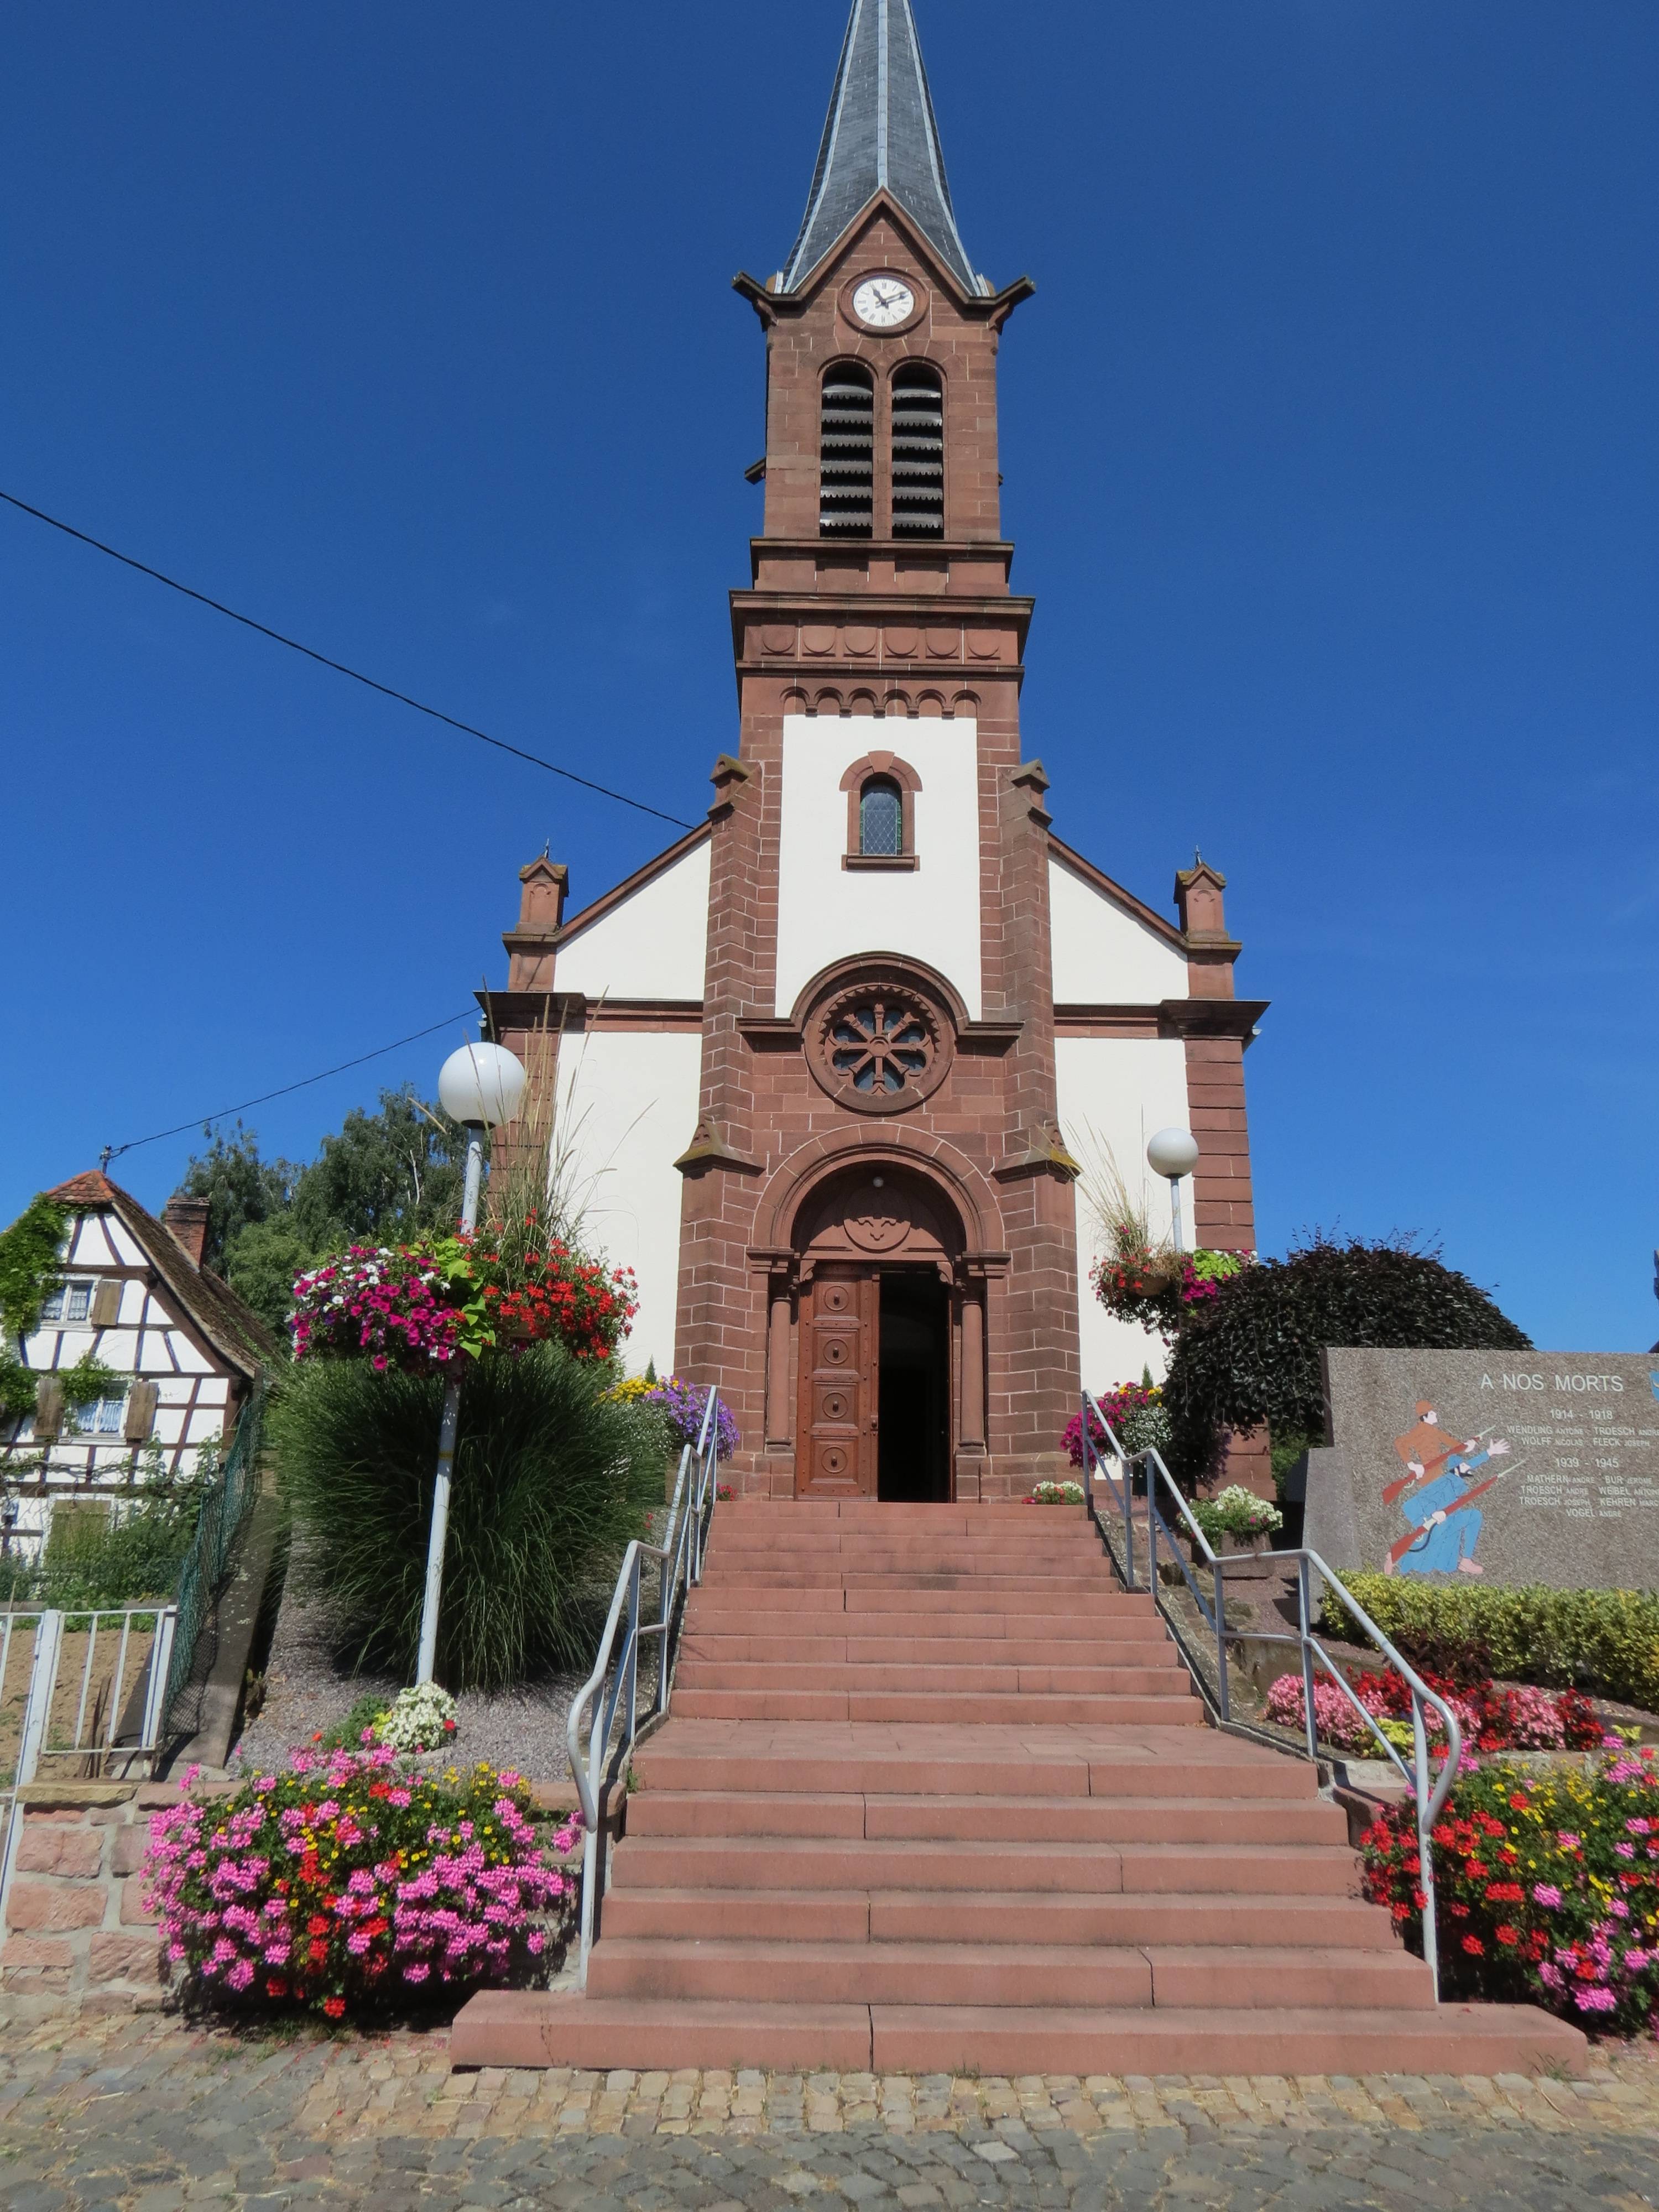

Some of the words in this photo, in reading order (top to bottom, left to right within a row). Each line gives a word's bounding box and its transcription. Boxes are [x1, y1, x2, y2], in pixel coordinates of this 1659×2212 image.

[1480, 1374, 1494, 1389] A
[1503, 1374, 1544, 1390] NOS
[1555, 1375, 1624, 1392] MORTS
[1550, 1410, 1574, 1420] 1914
[1589, 1410, 1613, 1420] 1918
[1507, 1425, 1553, 1434] WENDLING
[1594, 1427, 1635, 1436] TROESCH
[1521, 1437, 1553, 1445] WOLFF
[1593, 1438, 1621, 1446] FLECK
[1556, 1457, 1579, 1467] 1939
[1595, 1458, 1619, 1468] 1945
[1526, 1475, 1569, 1483] MATHERN
[1605, 1475, 1624, 1484] BUR
[1521, 1485, 1562, 1494] TROESCH
[1598, 1486, 1631, 1495] WEIBEL
[1519, 1496, 1561, 1505] TROESCH
[1600, 1498, 1636, 1506] KEHREN
[1566, 1509, 1596, 1517] VOGEL
